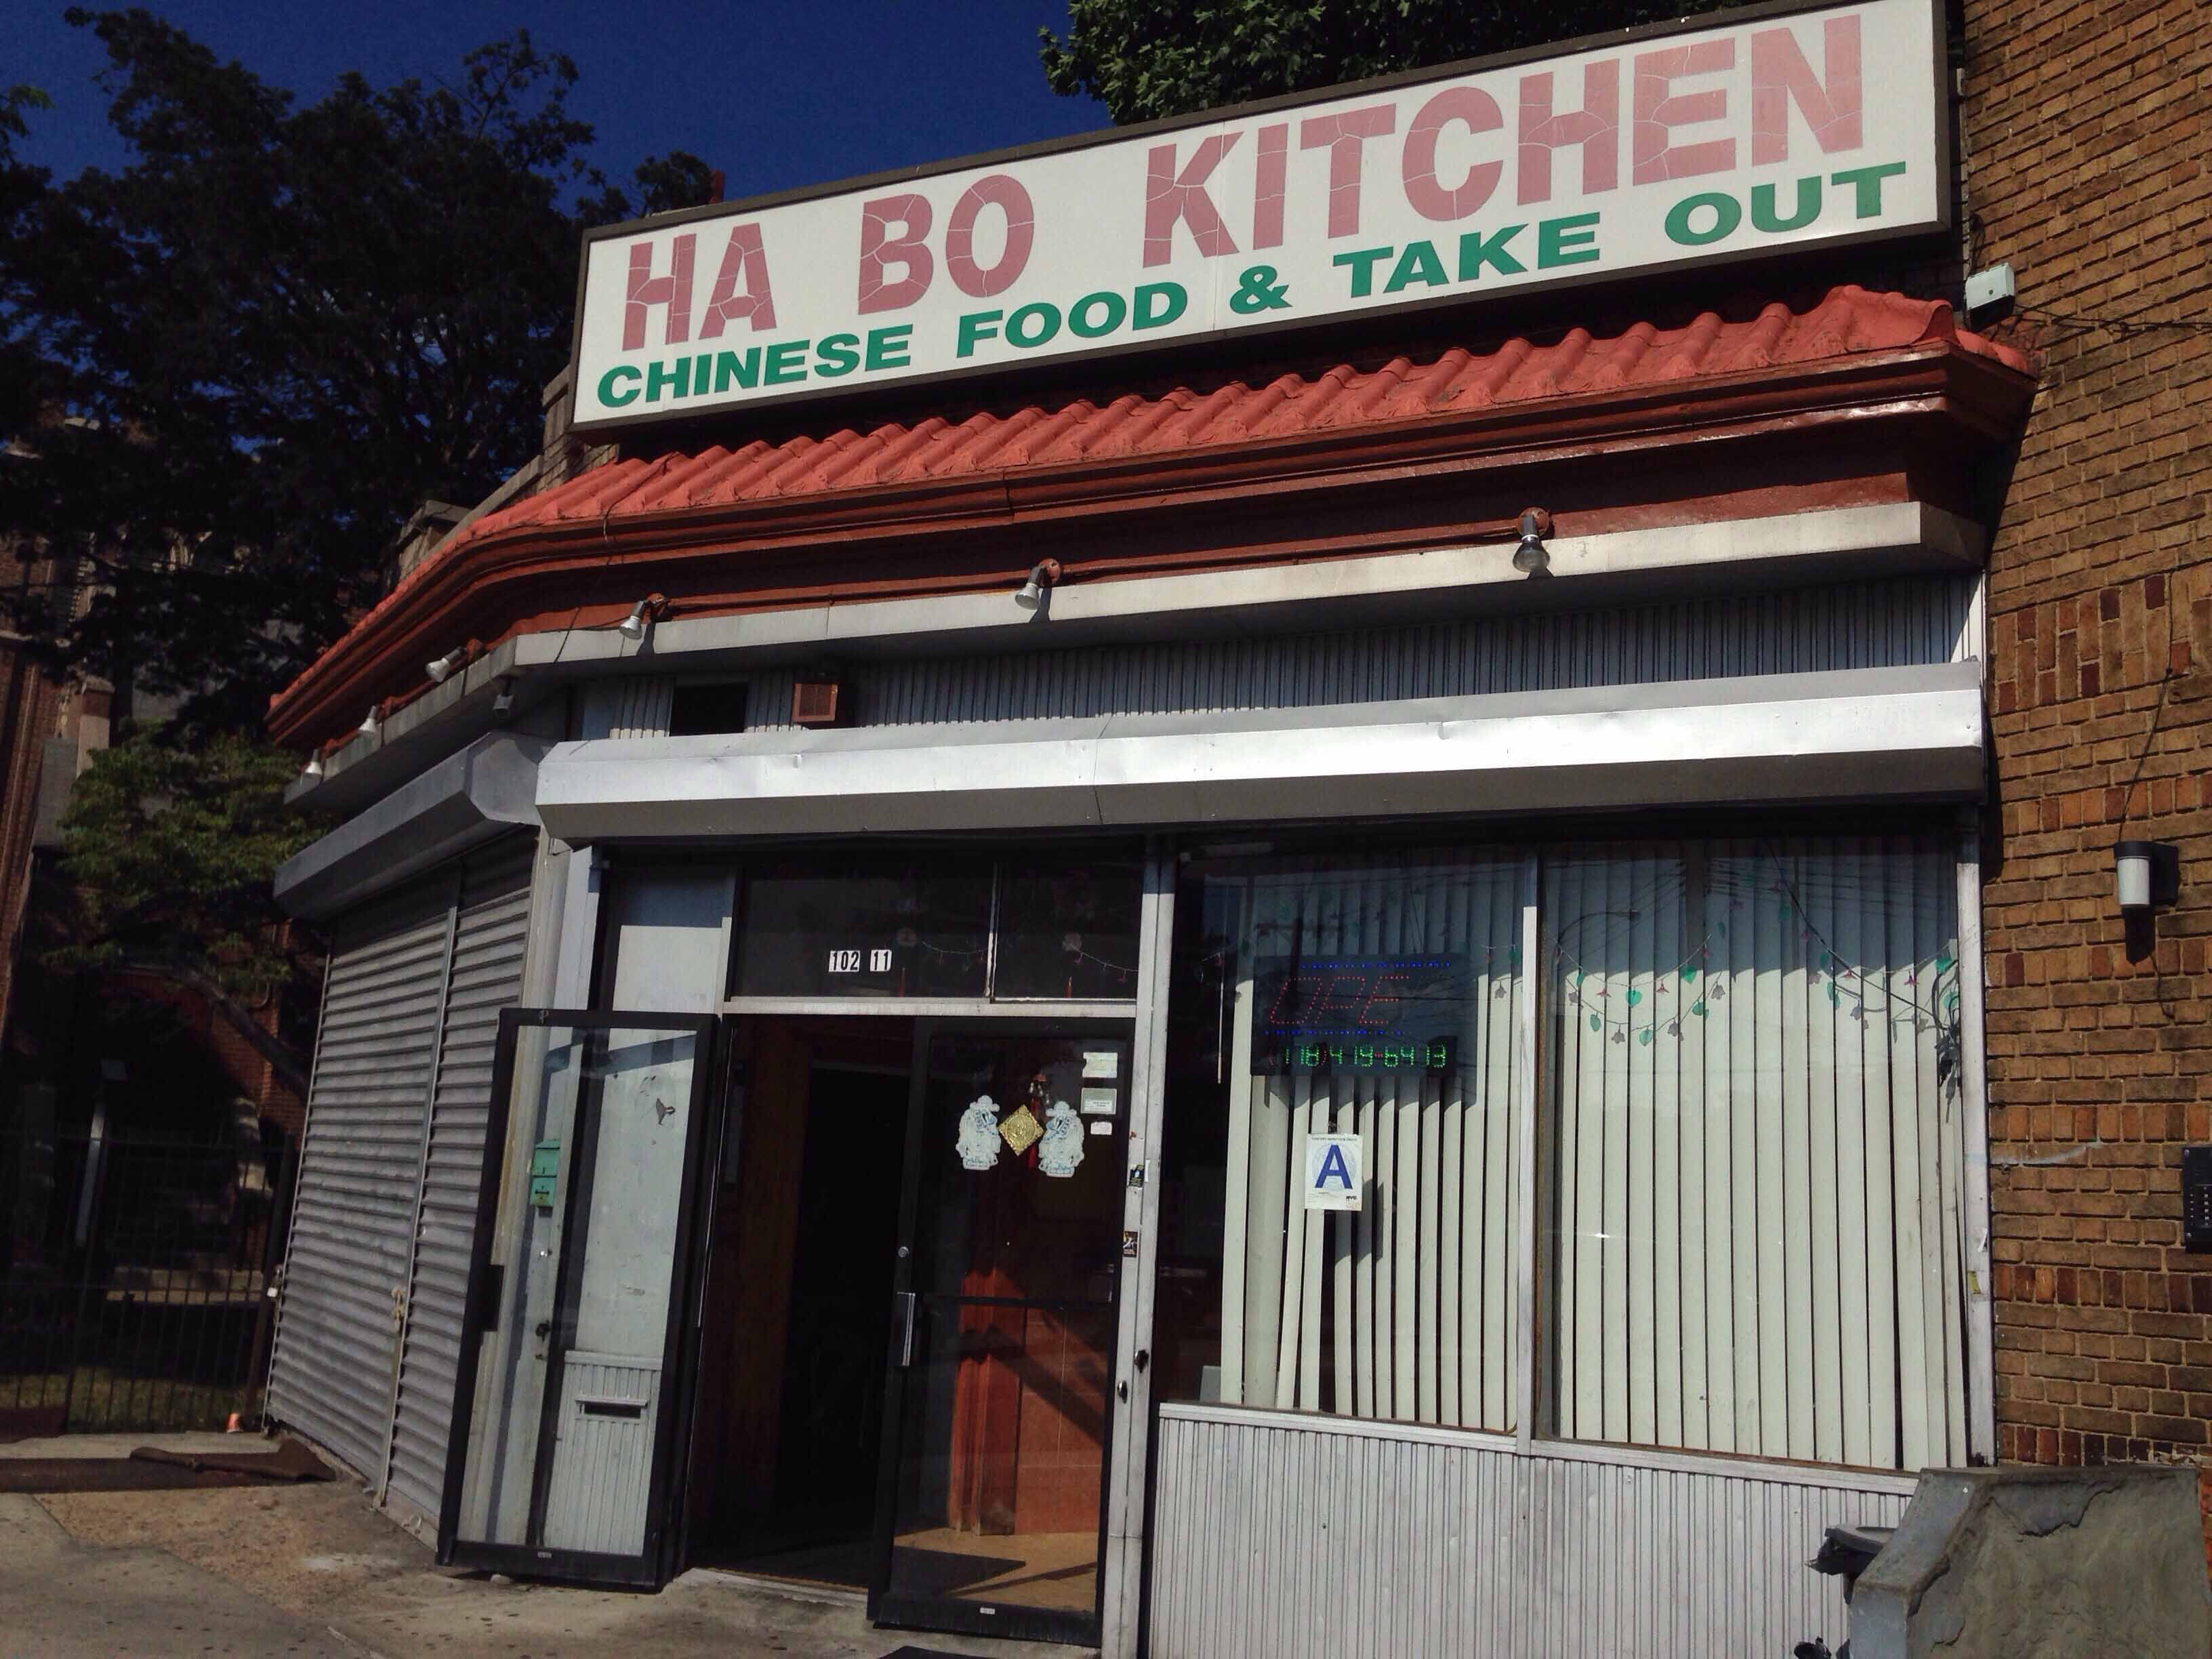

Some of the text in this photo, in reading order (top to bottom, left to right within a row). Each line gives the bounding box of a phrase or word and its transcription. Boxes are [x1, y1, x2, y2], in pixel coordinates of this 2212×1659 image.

[623, 14, 1864, 351] HA BO KITCHEN
[597, 161, 1906, 408] CHINESE FOOD & TAKE OUT
[833, 951, 889, 971] 102 11
[1315, 1144, 1353, 1189] A
